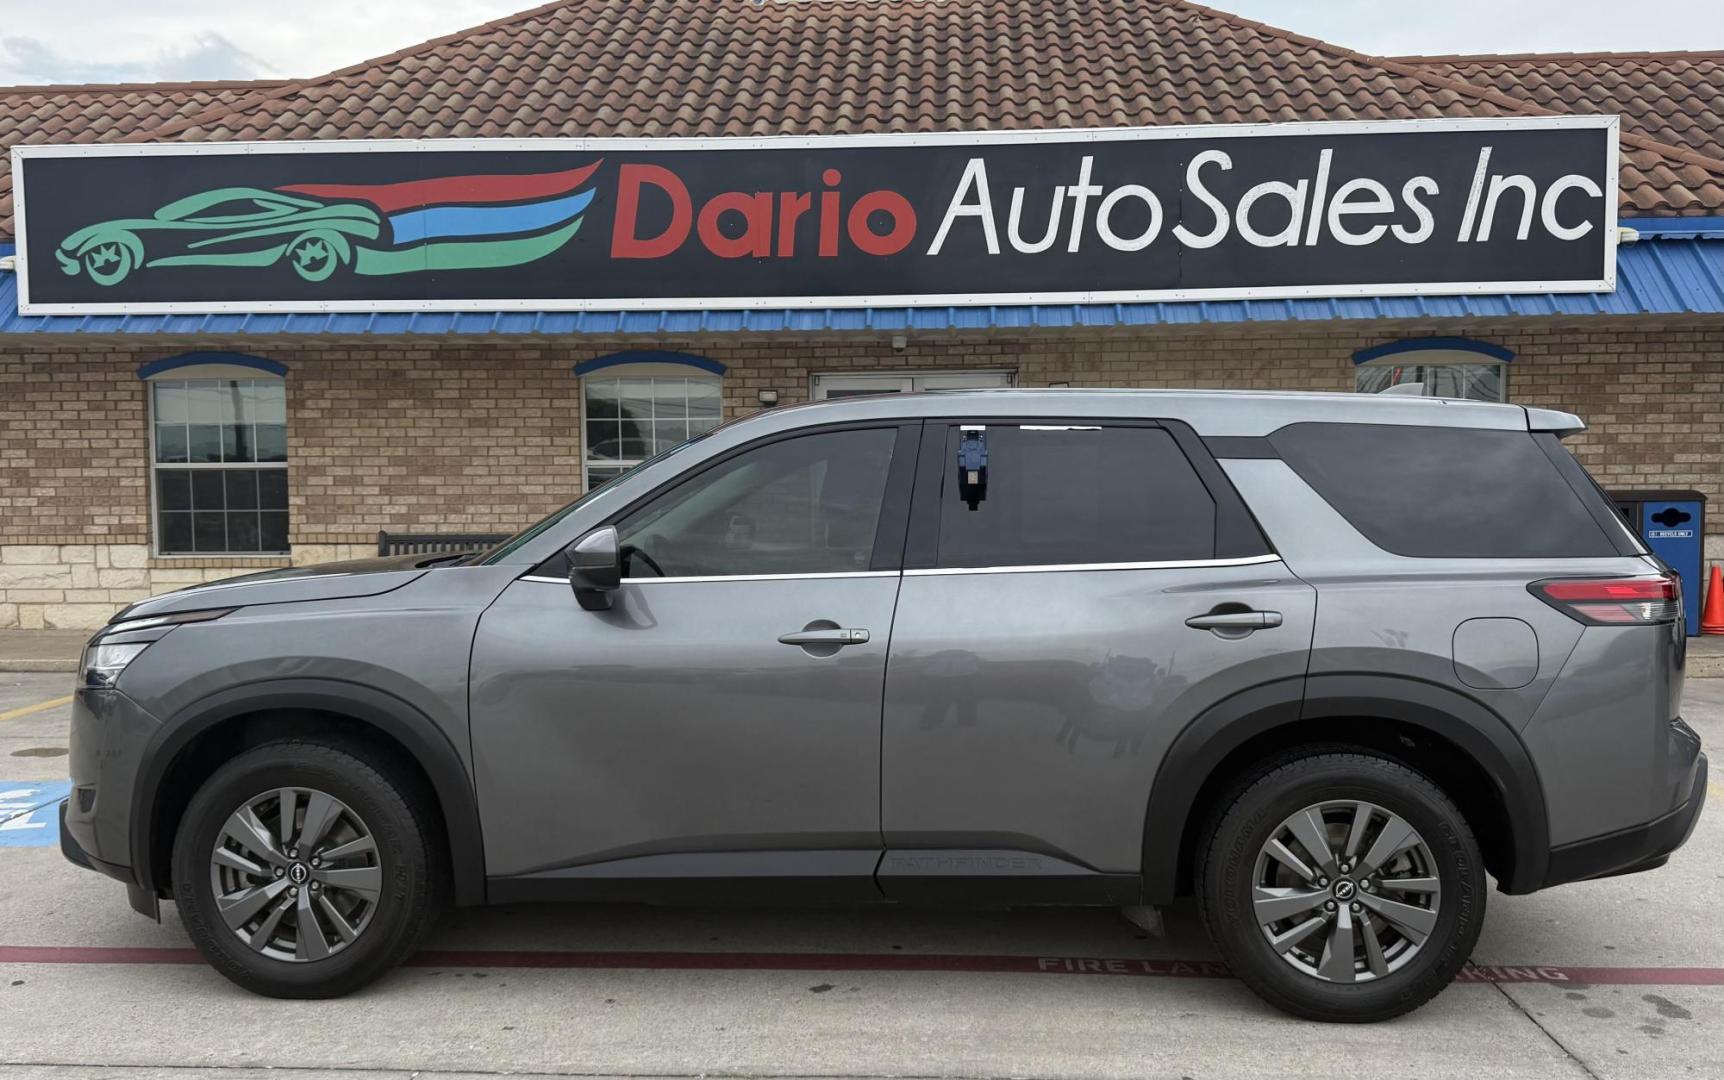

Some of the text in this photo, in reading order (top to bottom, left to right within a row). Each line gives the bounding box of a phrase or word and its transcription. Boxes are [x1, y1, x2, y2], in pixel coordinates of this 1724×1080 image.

[610, 146, 1603, 259] Dario Auto Sales Inc
[889, 857, 1043, 871] PATHFINDER
[1037, 957, 1129, 973] FIRE
[1142, 960, 1227, 976] LAN
